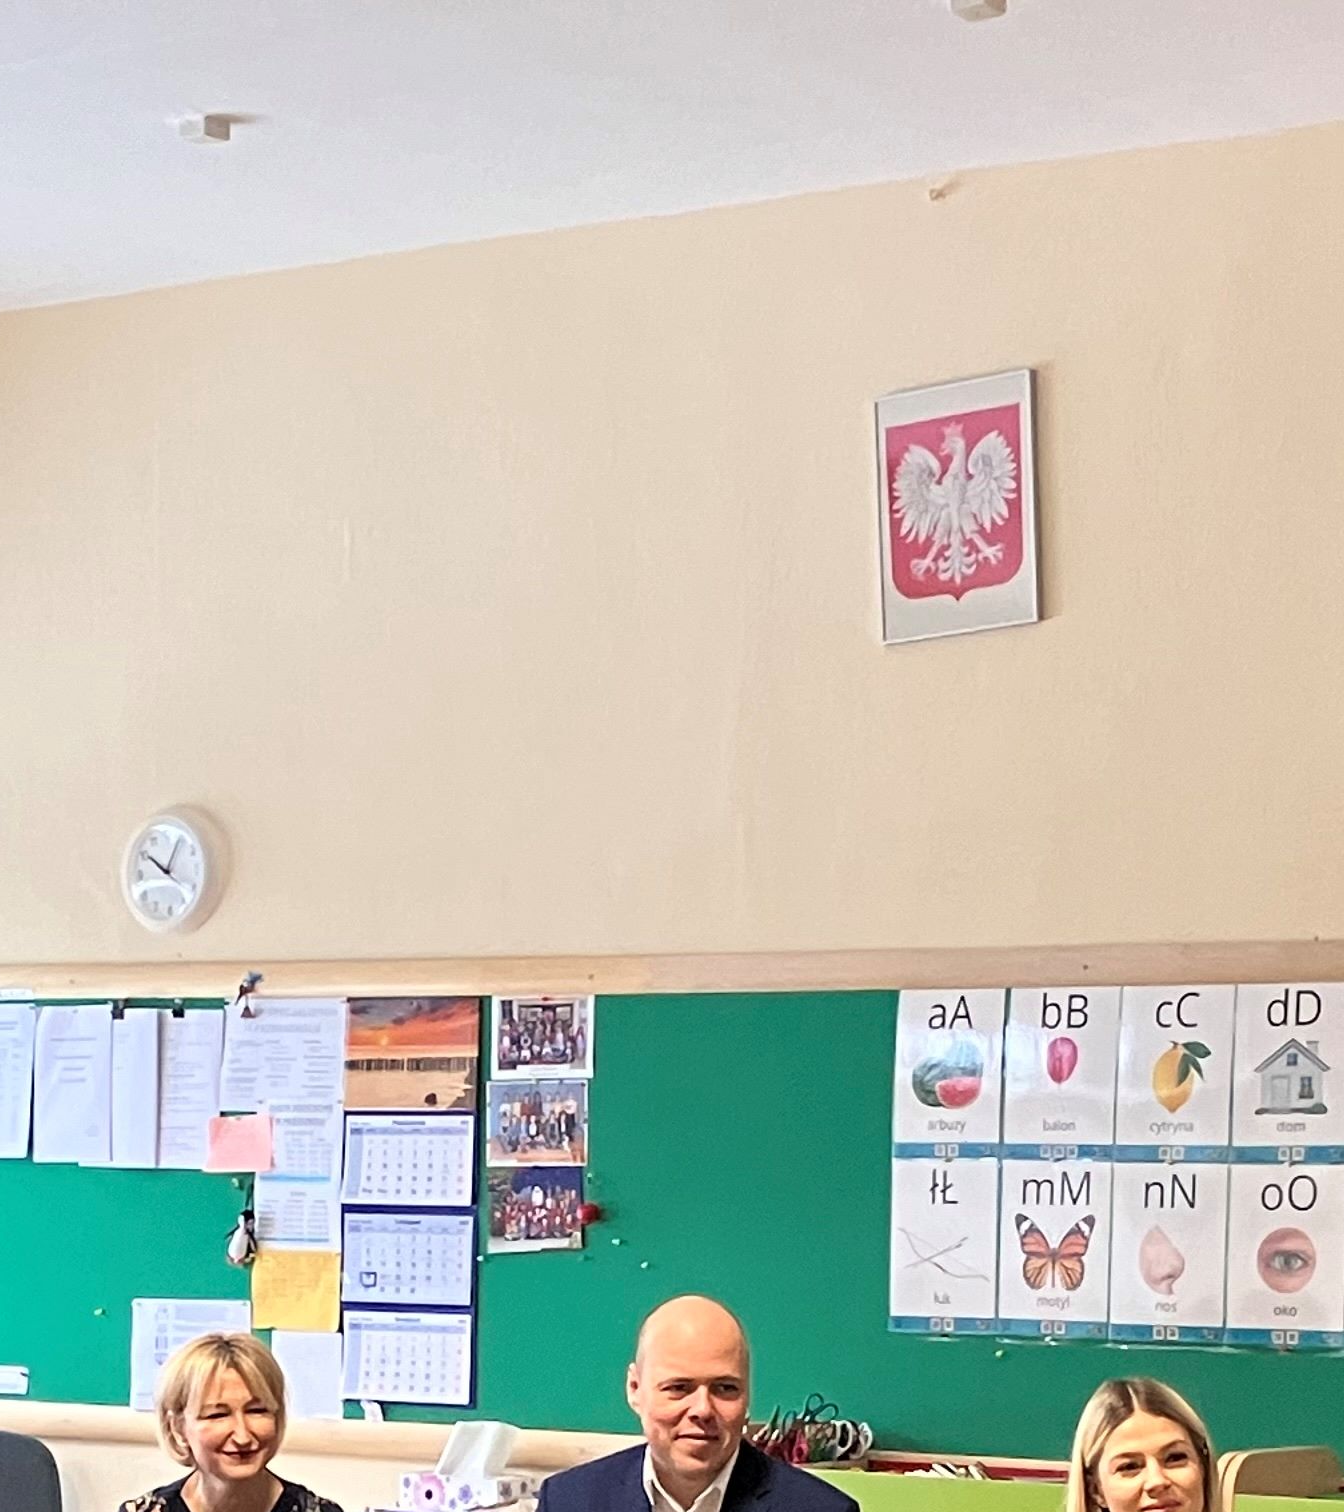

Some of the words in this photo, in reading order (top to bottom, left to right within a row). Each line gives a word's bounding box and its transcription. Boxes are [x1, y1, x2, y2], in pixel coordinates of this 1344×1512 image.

[929, 995, 972, 1029] aA
[1042, 993, 1088, 1029] bB
[1156, 992, 1200, 1028] cC
[1267, 988, 1321, 1026] dD
[1277, 1122, 1306, 1132] dom
[1023, 1171, 1090, 1205] mM
[1144, 1174, 1196, 1208] nN
[1261, 1175, 1317, 1211] oO
[1273, 1305, 1297, 1317] oko
